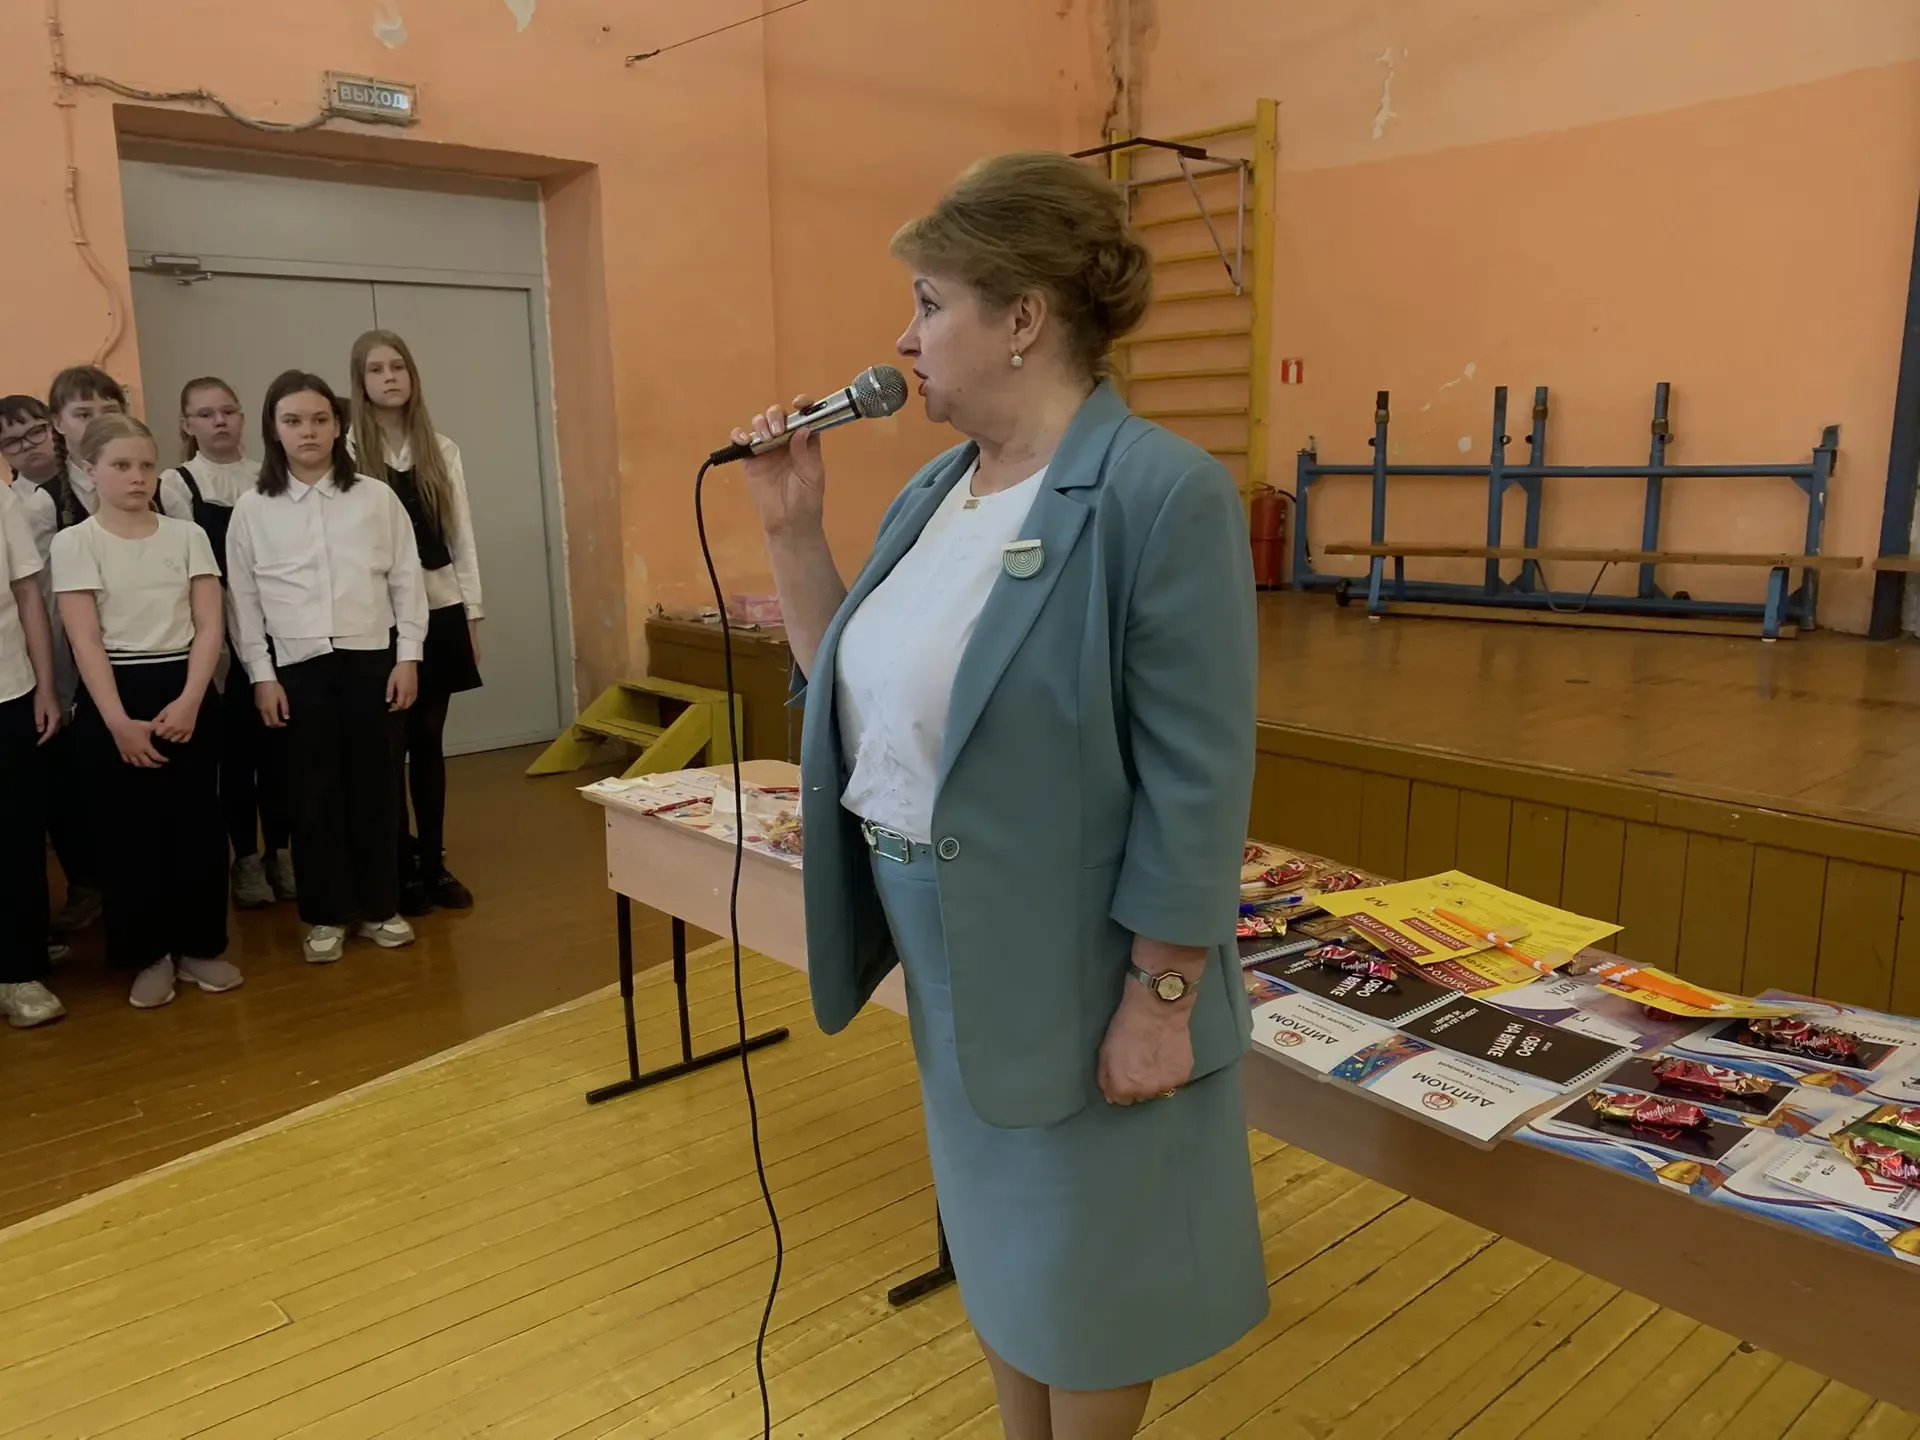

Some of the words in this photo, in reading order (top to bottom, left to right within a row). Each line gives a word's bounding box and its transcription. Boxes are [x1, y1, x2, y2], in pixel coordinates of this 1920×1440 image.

[340, 85, 404, 109] ВЫХОД
[1354, 914, 1381, 930] РУНО
[1411, 907, 1472, 938] РТИФИКАТ
[1380, 928, 1426, 955] ЗОЛОТОЕ
[1424, 965, 1477, 991] ЗОЛОТОЕ
[1268, 1012, 1339, 1045] ДИПЛОМ
[1504, 1022, 1525, 1034] НА
[1486, 1033, 1516, 1058] ВЯТКЕ
[1412, 1072, 1495, 1107] ДИПЛОМ
[1636, 1104, 1676, 1123] Emotion
